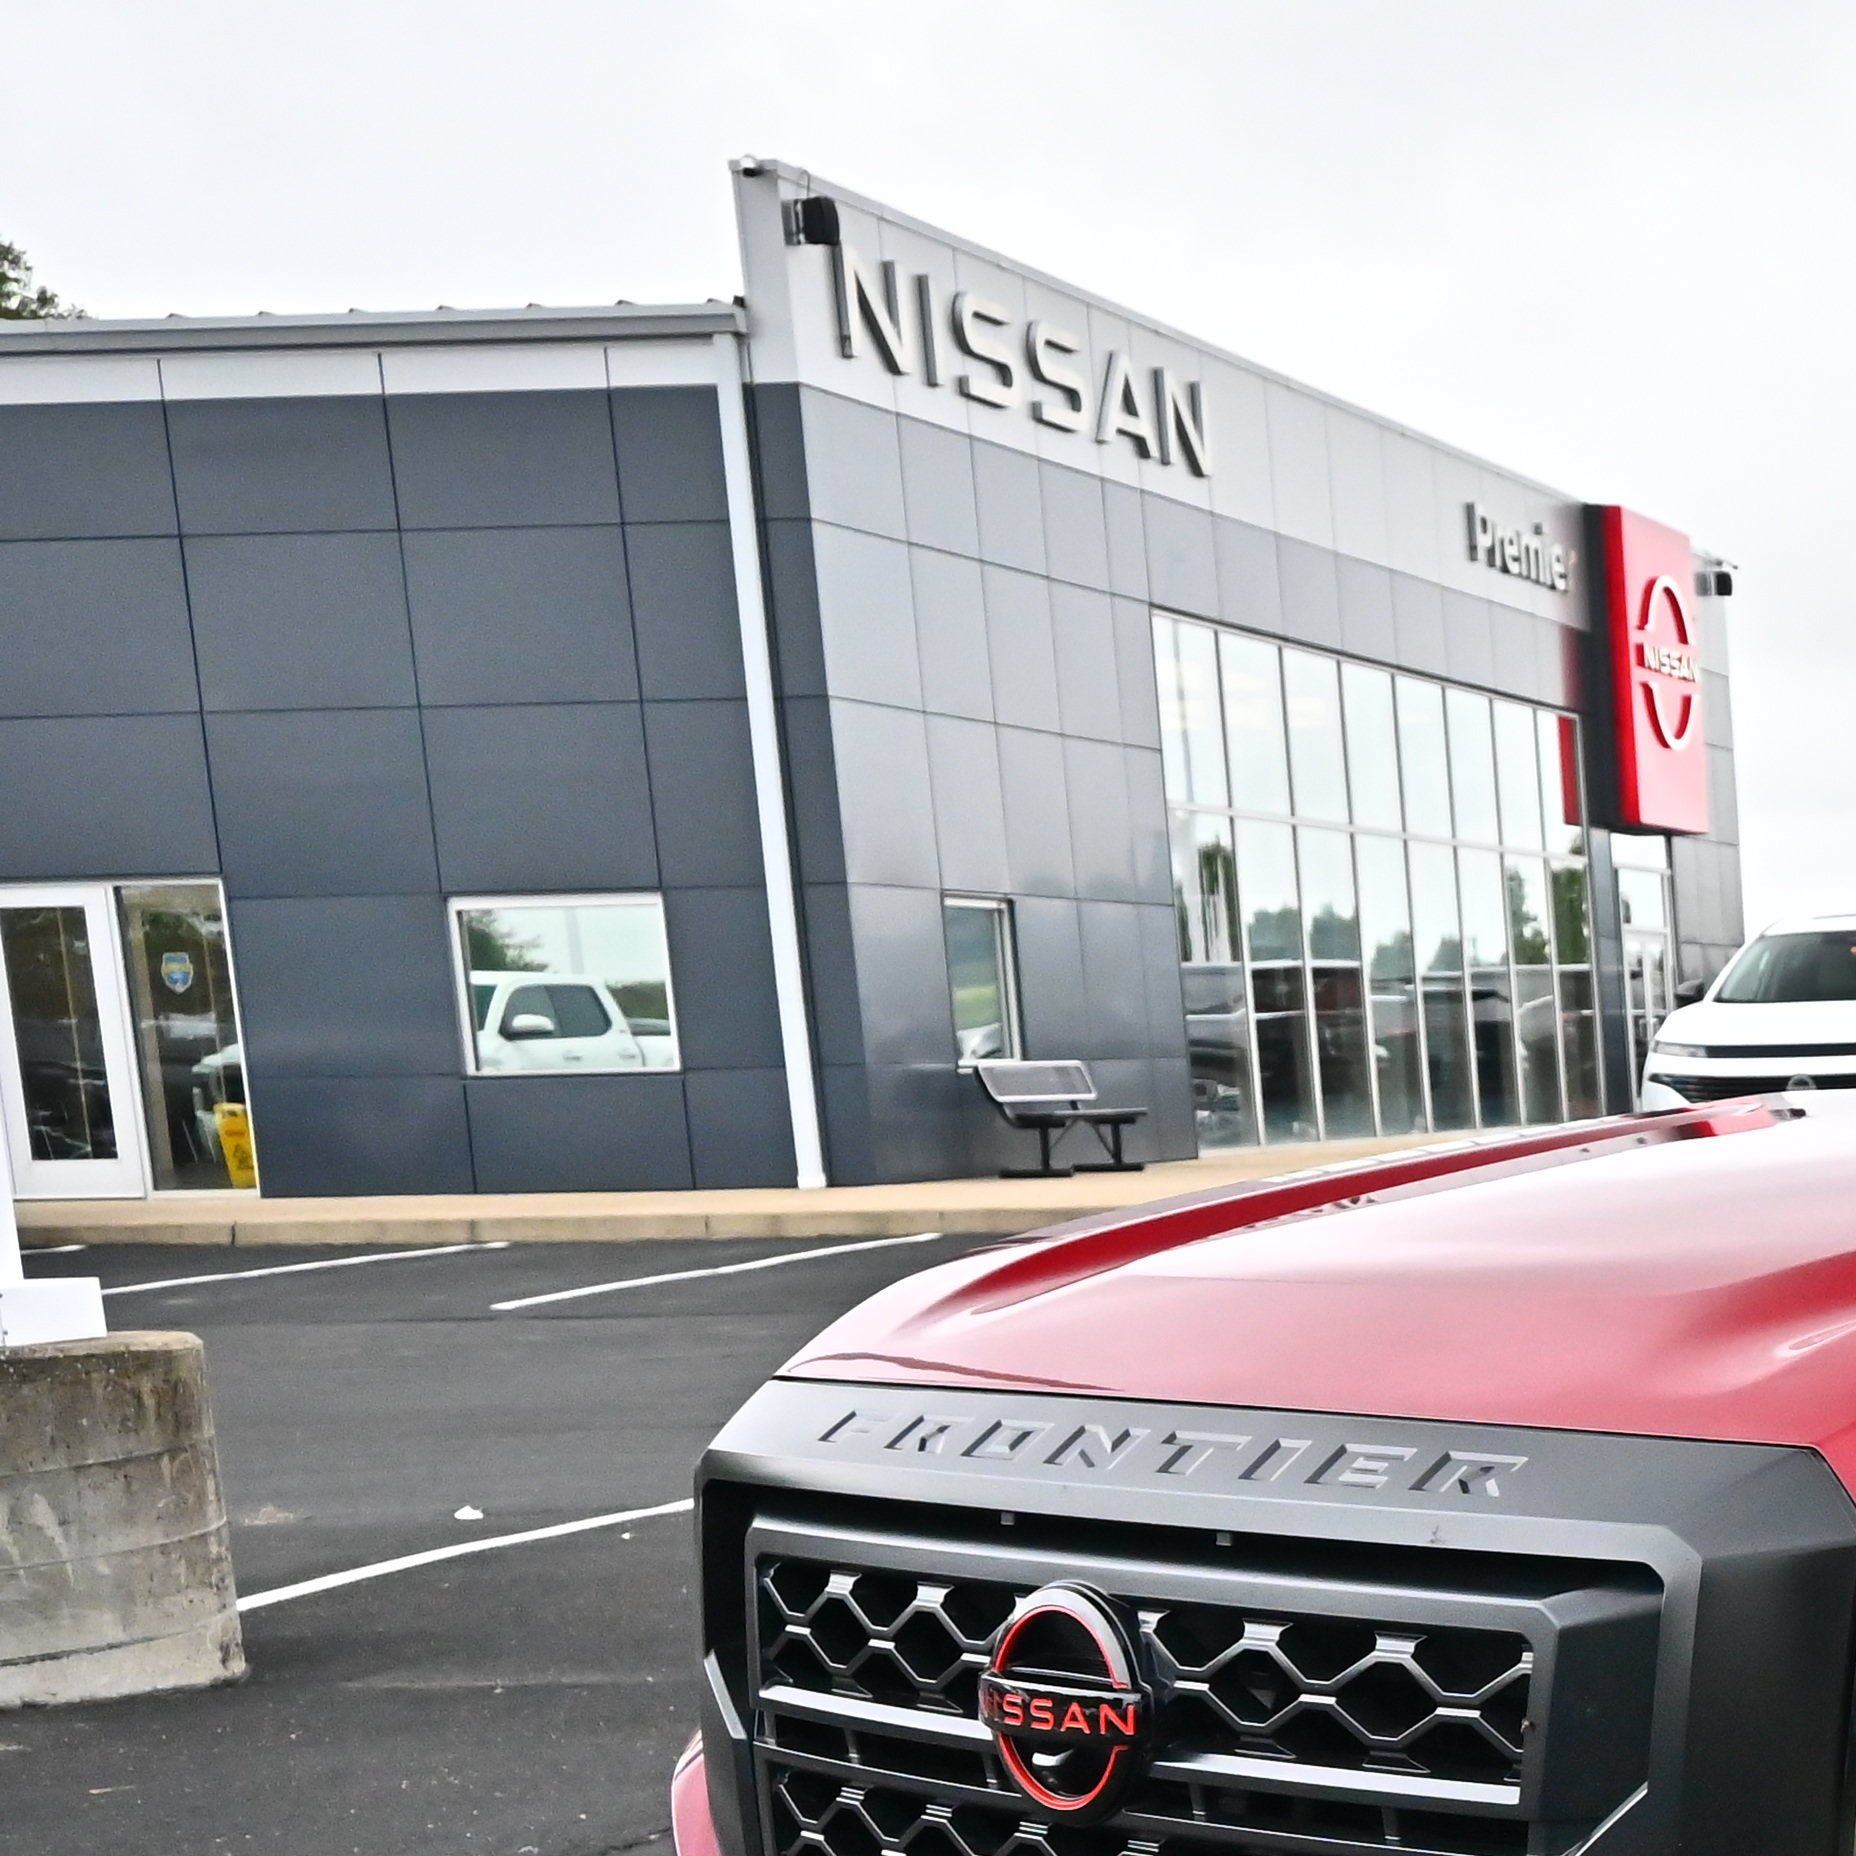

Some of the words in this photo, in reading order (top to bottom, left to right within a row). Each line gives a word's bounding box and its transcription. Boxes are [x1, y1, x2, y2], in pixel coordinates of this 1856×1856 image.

[832, 240, 1212, 478] NISSAN
[1642, 641, 1700, 682] NISSAN
[818, 1409, 1529, 1498] FRONTIER
